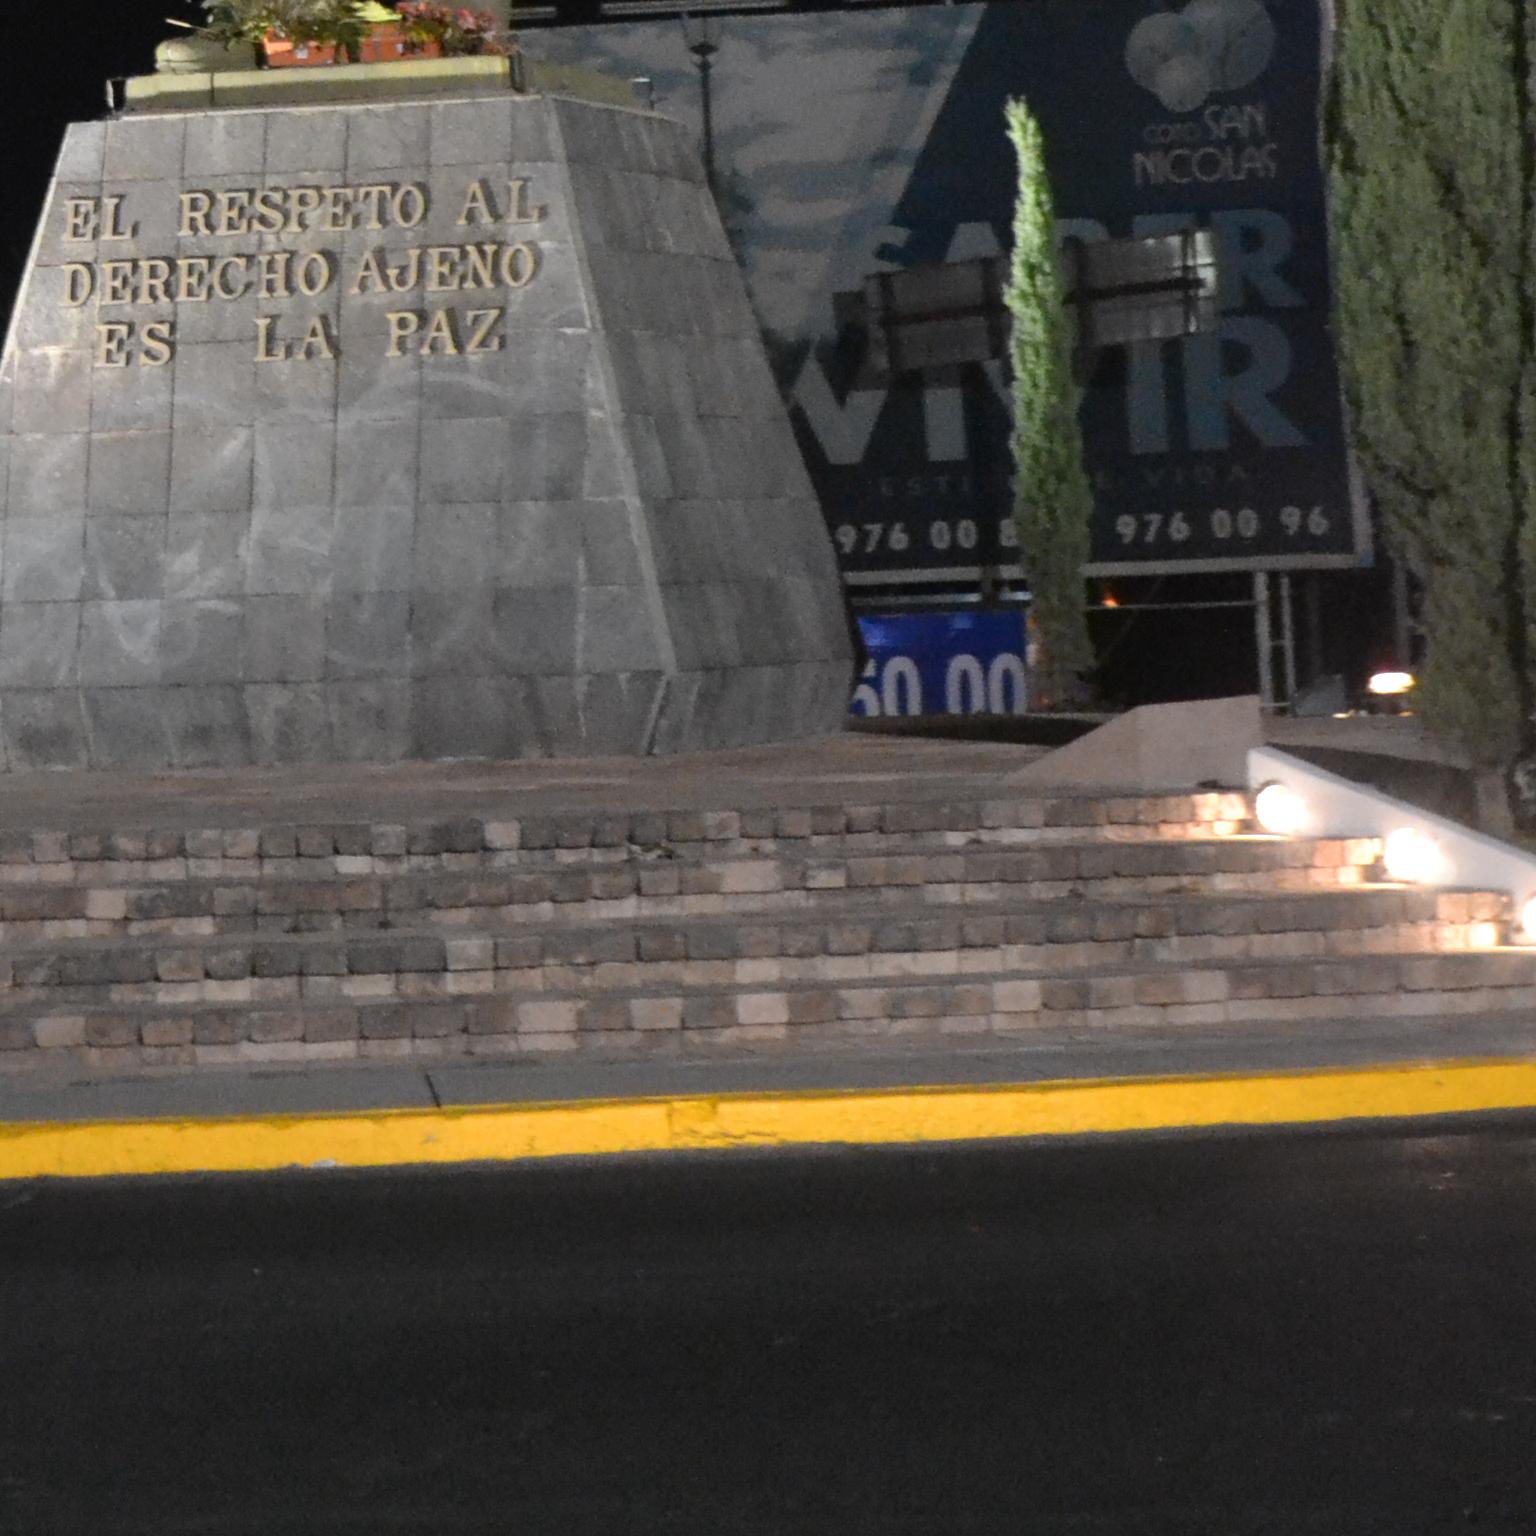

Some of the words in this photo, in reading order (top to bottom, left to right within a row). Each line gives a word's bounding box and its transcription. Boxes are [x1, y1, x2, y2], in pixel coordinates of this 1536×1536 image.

[1203, 101, 1267, 141] SAN
[1132, 139, 1278, 188] NICOLAS
[61, 194, 134, 244] EL
[177, 184, 426, 237] RESPETO
[456, 180, 541, 226] AL
[61, 252, 331, 309] DERECHO
[350, 243, 537, 295] AJENO
[94, 322, 173, 369] ES
[254, 314, 334, 362] LA
[384, 308, 502, 359] PAZ
[834, 522, 911, 554] 976
[929, 518, 978, 551] 00
[1115, 510, 1192, 544] 976
[1210, 507, 1260, 540] 00
[1279, 505, 1331, 537] 96
